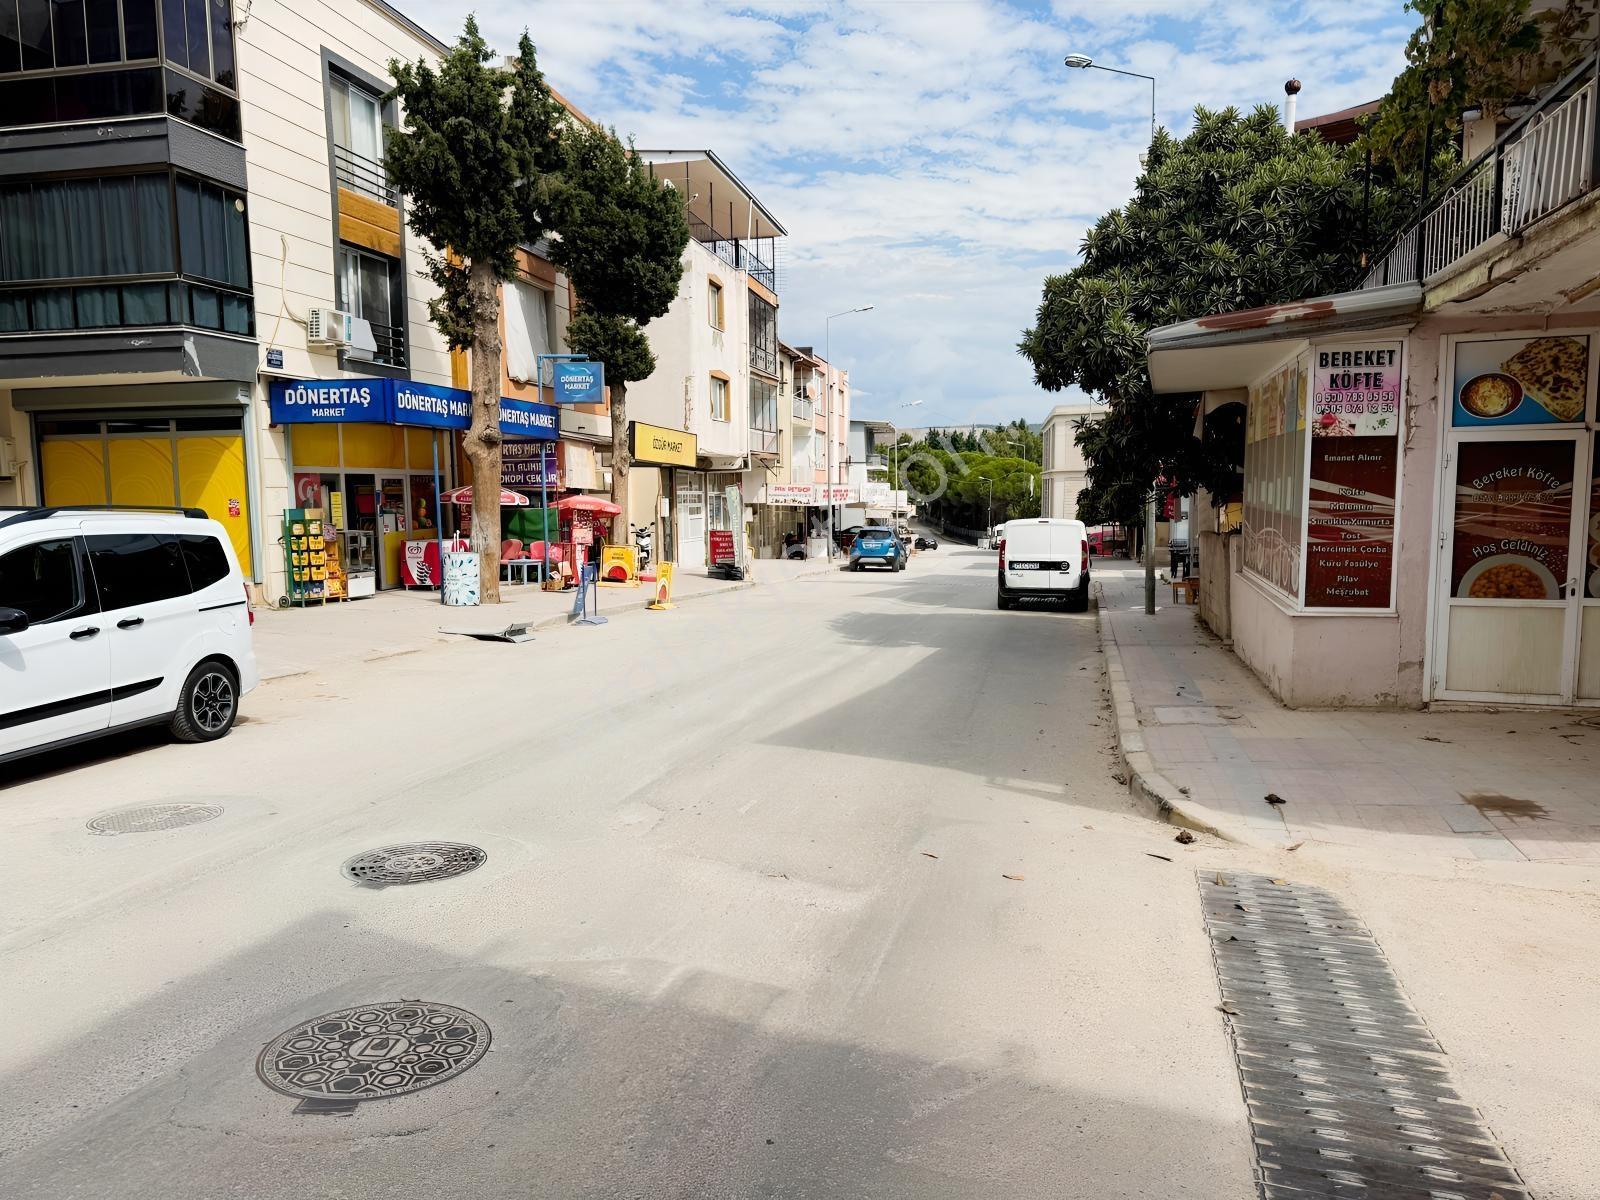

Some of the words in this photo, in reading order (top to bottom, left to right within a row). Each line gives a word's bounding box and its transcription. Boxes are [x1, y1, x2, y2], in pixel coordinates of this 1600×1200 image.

[1320, 350, 1395, 368] BEREKET
[1329, 369, 1383, 389] KÖFTE
[285, 385, 371, 407] DÖNERTAŞ
[397, 390, 448, 418] DÖNERTAŞ
[312, 407, 345, 417] MARKET
[530, 412, 556, 428] MARKET
[524, 443, 556, 456] MARET
[1324, 454, 1355, 462] Emanet
[1472, 467, 1522, 490] Bereket
[1526, 467, 1560, 489] Köfte
[1339, 532, 1361, 540] Tost
[1312, 545, 1357, 553] Mercimek
[1472, 543, 1498, 558] Hoş
[1501, 539, 1549, 558] Geldiniz
[1326, 588, 1369, 597] Meşrubat
